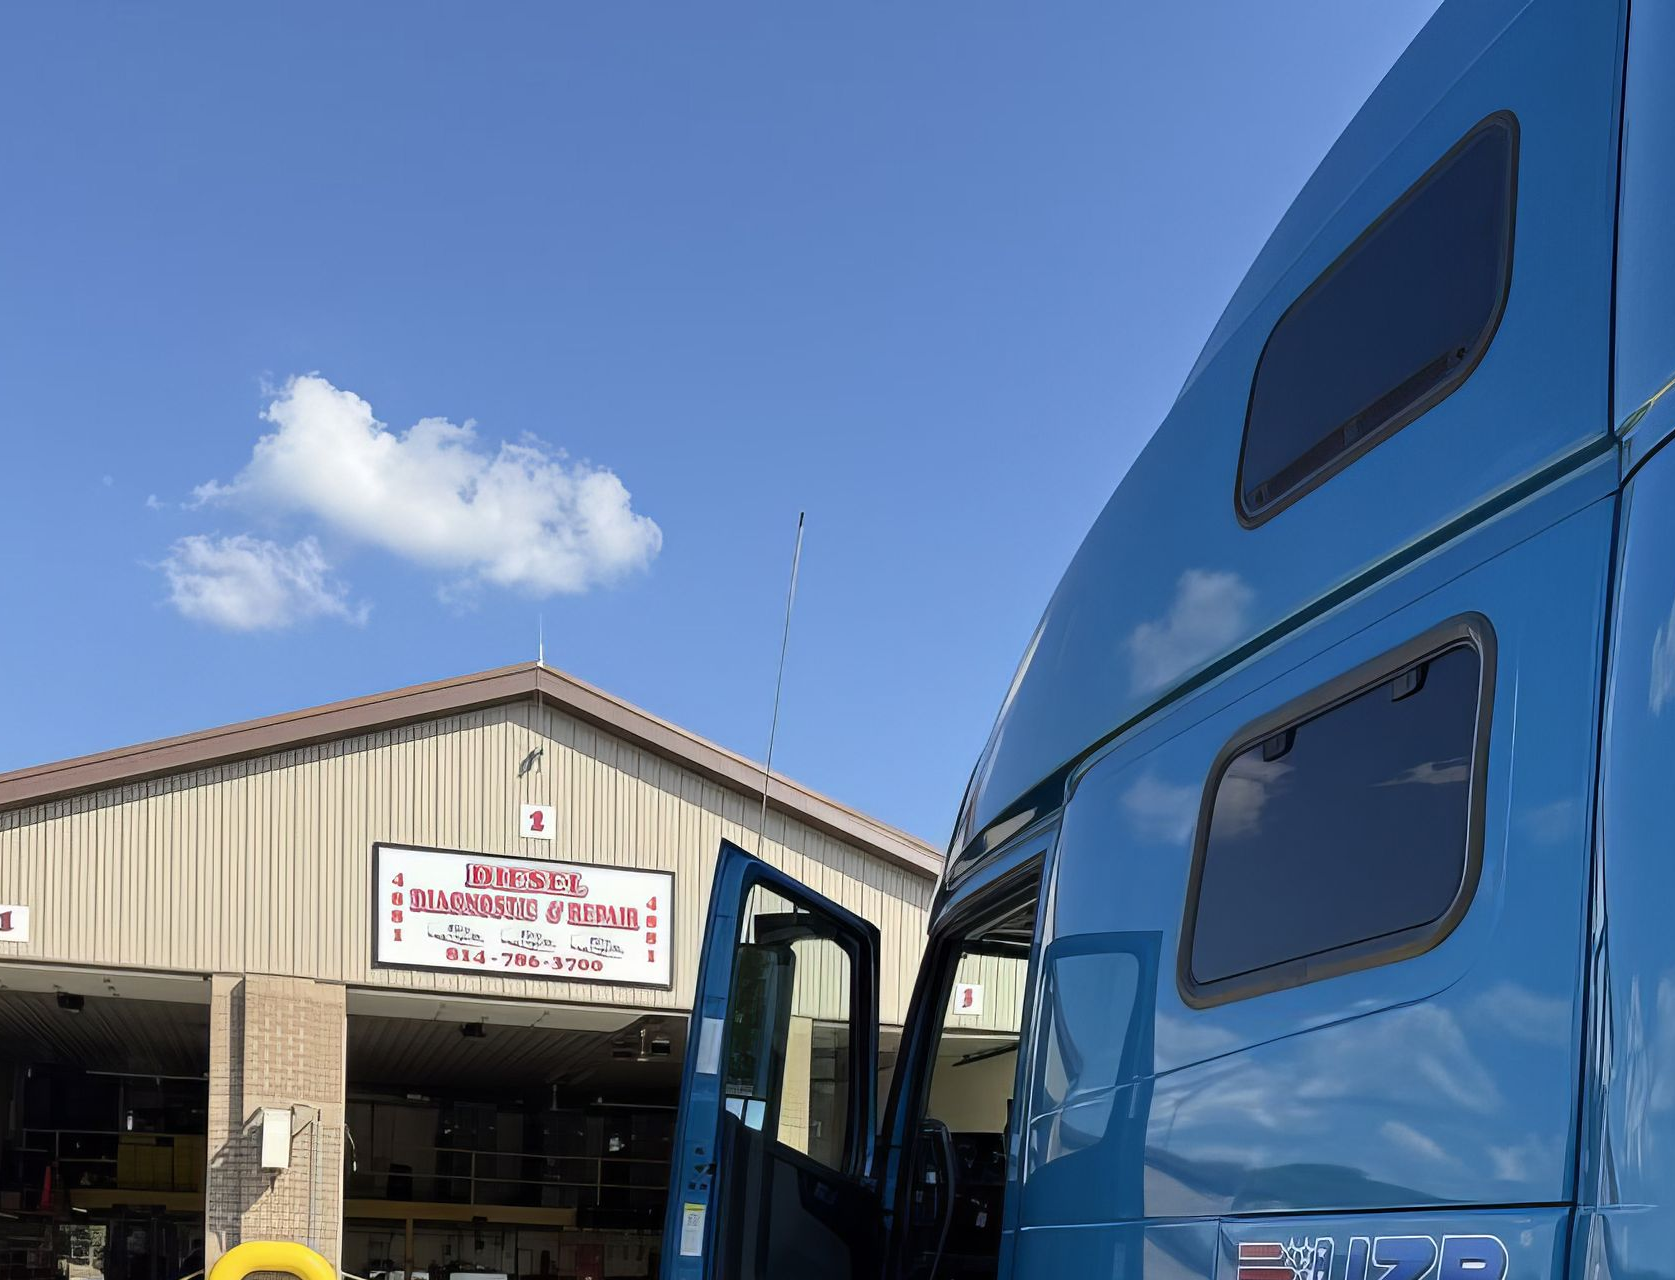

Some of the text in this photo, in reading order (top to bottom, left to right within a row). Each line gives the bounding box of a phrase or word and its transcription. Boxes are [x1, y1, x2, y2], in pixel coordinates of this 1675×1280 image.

[528, 810, 545, 832] 2
[465, 863, 589, 898] DIESEL
[409, 888, 640, 931] DIAGNOSTIC & REPAIR
